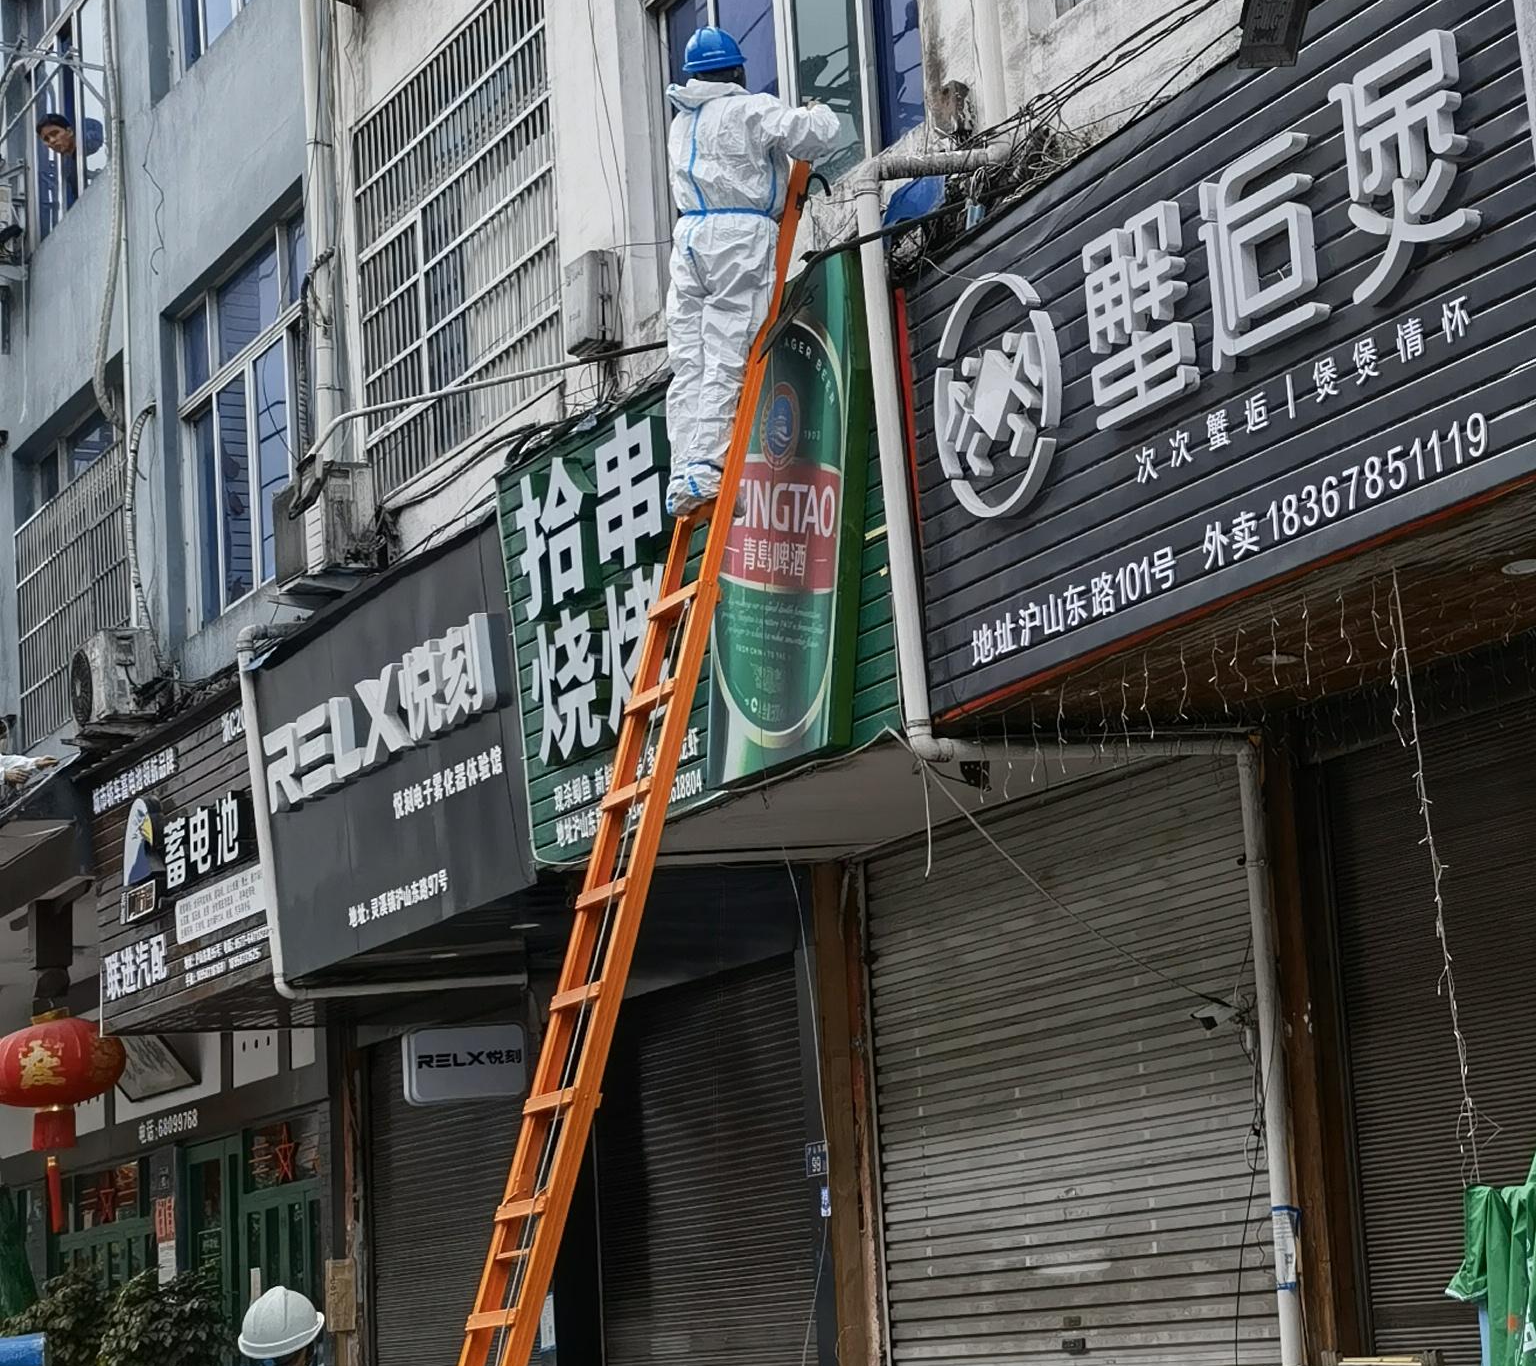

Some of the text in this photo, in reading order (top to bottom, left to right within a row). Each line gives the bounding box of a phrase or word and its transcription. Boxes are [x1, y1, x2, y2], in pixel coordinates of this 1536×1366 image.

[1082, 29, 1481, 429] 蟹逅煲
[783, 337, 812, 360] AGER
[515, 413, 663, 622] 拾串
[732, 479, 838, 539] INGTAO
[970, 545, 1178, 666] 地址沪山东路101号
[1201, 510, 1261, 571] 外卖
[1267, 411, 1490, 542] 18367851119
[262, 612, 497, 815] RELX悦刻
[392, 744, 504, 820] 悦刻电子雾化器体验馆
[163, 790, 240, 890] 蓄电池
[417, 1048, 522, 1069] RELX悦刻
